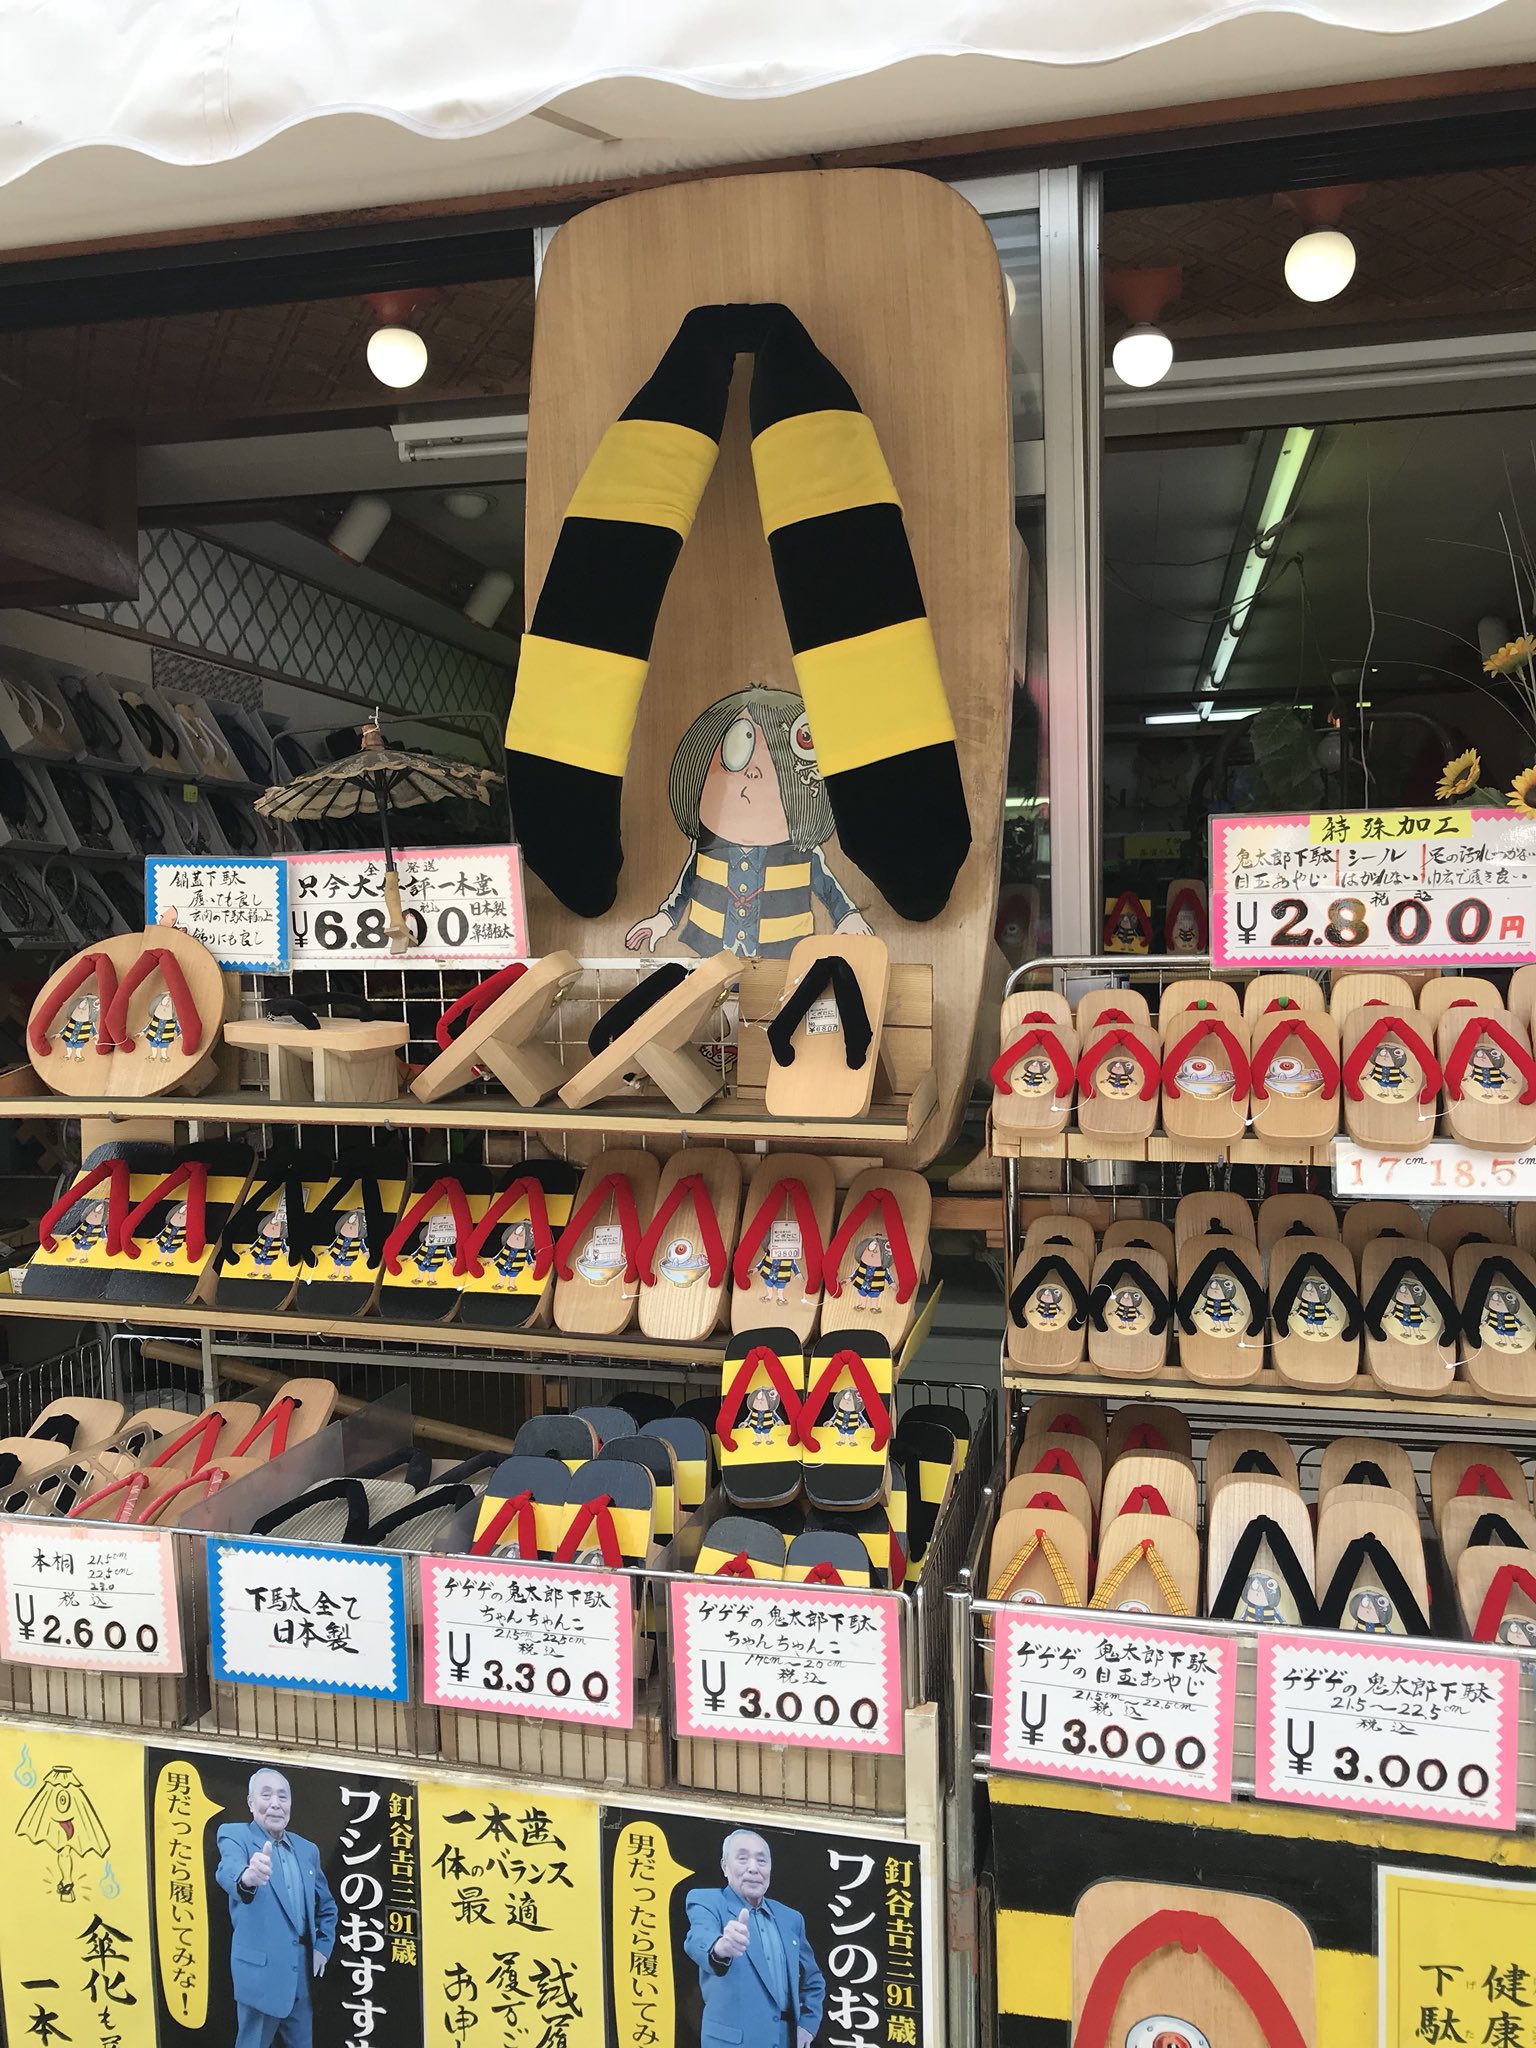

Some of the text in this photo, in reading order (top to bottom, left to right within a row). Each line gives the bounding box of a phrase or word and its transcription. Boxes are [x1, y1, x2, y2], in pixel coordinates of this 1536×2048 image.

[1322, 815, 1460, 843] 特殊加工
[364, 862, 439, 876] 全発送
[1232, 846, 1336, 873] 鬼太郎下駄
[1347, 847, 1407, 867] シール
[297, 871, 499, 901] 只今大評一本歯
[1234, 870, 1328, 891] 目玉おやじ
[469, 899, 508, 918] 日本製
[31, 1548, 75, 1576] 本桐
[57, 1591, 114, 1610] 税込
[244, 1586, 362, 1620] 下駄全て
[479, 1604, 585, 1632] ちゃんちゃんこ
[273, 1617, 360, 1654] 日本製
[724, 1630, 842, 1657] ちゃんちゃんこ
[517, 1643, 566, 1659] 税込
[1094, 1638, 1218, 1676] 鬼太郎下駄
[777, 1668, 828, 1685] 税込
[1096, 1665, 1205, 1698] 目玉おやじ
[1089, 1701, 1150, 1721] 税込
[1355, 1718, 1420, 1736] 税込
[442, 1802, 567, 1852] 一本歯
[431, 1843, 574, 1889] 体のバランス
[338, 1785, 388, 2048] ワシのおすす
[451, 1886, 555, 1933] 最適
[76, 1913, 138, 2048] 傘化も
[443, 1961, 479, 2048] お申
[1414, 1964, 1468, 2046] 下駄
[1481, 1962, 1534, 2048] 健康
